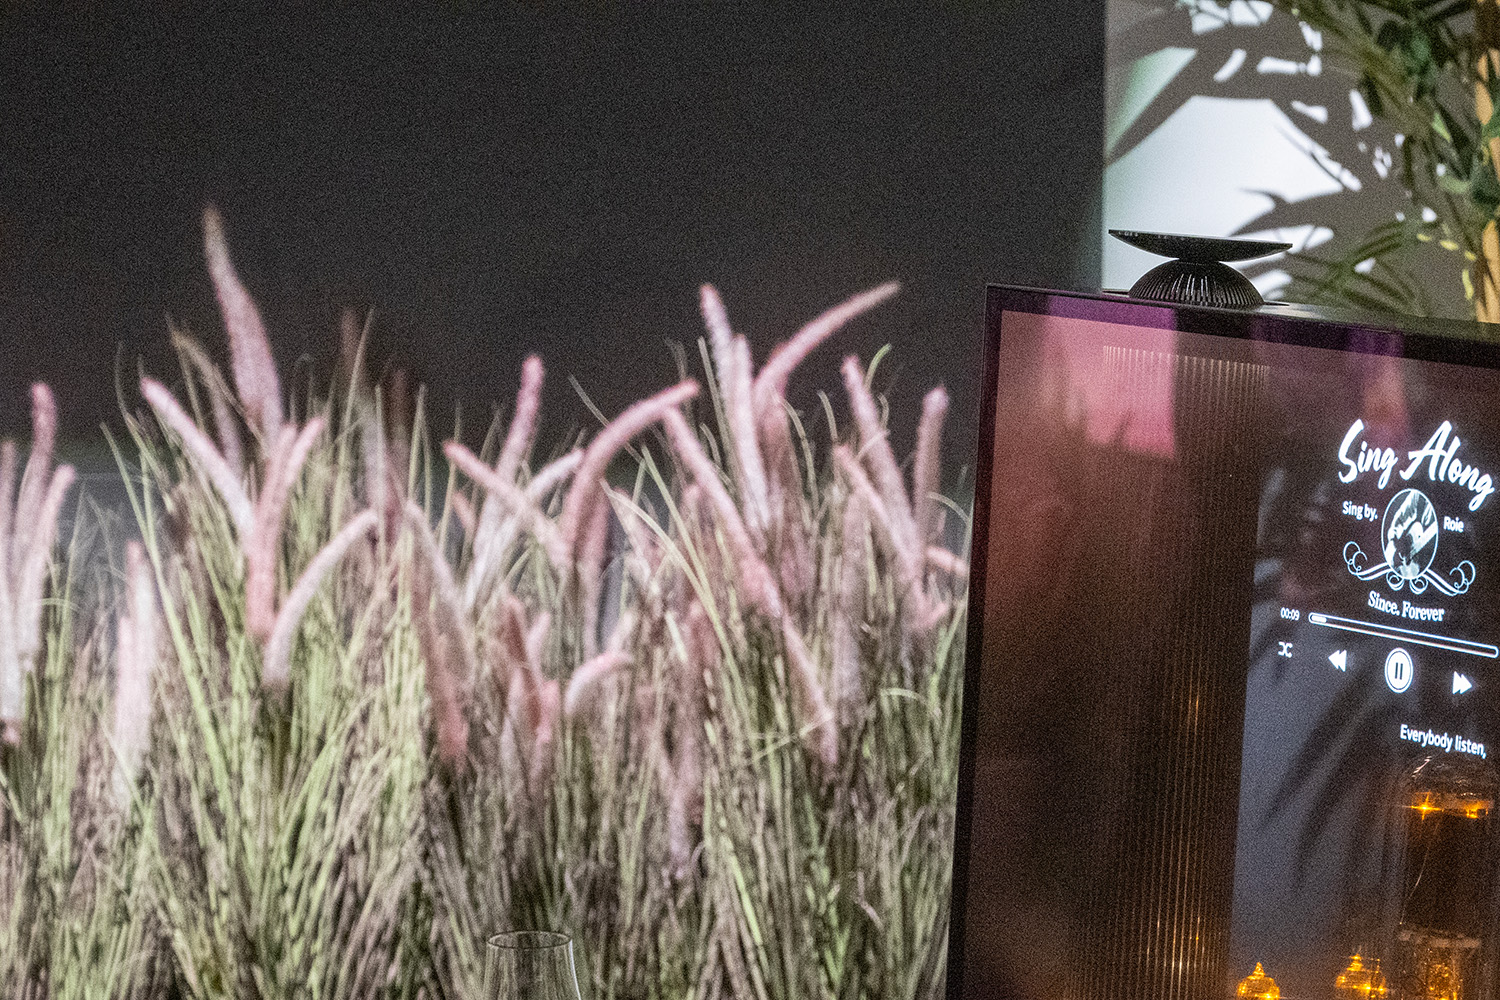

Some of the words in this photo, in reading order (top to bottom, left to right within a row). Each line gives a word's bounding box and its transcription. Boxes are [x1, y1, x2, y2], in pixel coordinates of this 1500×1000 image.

[1338, 418, 1399, 490] Sing
[1399, 420, 1496, 512] Along
[1341, 500, 1363, 521] Sing
[1443, 515, 1464, 533] Roie
[1280, 607, 1300, 621] 00:09
[1368, 591, 1400, 616] Since.
[1402, 601, 1446, 622] Forever
[1400, 724, 1453, 753] Everybody
[1455, 735, 1487, 760] listen,
